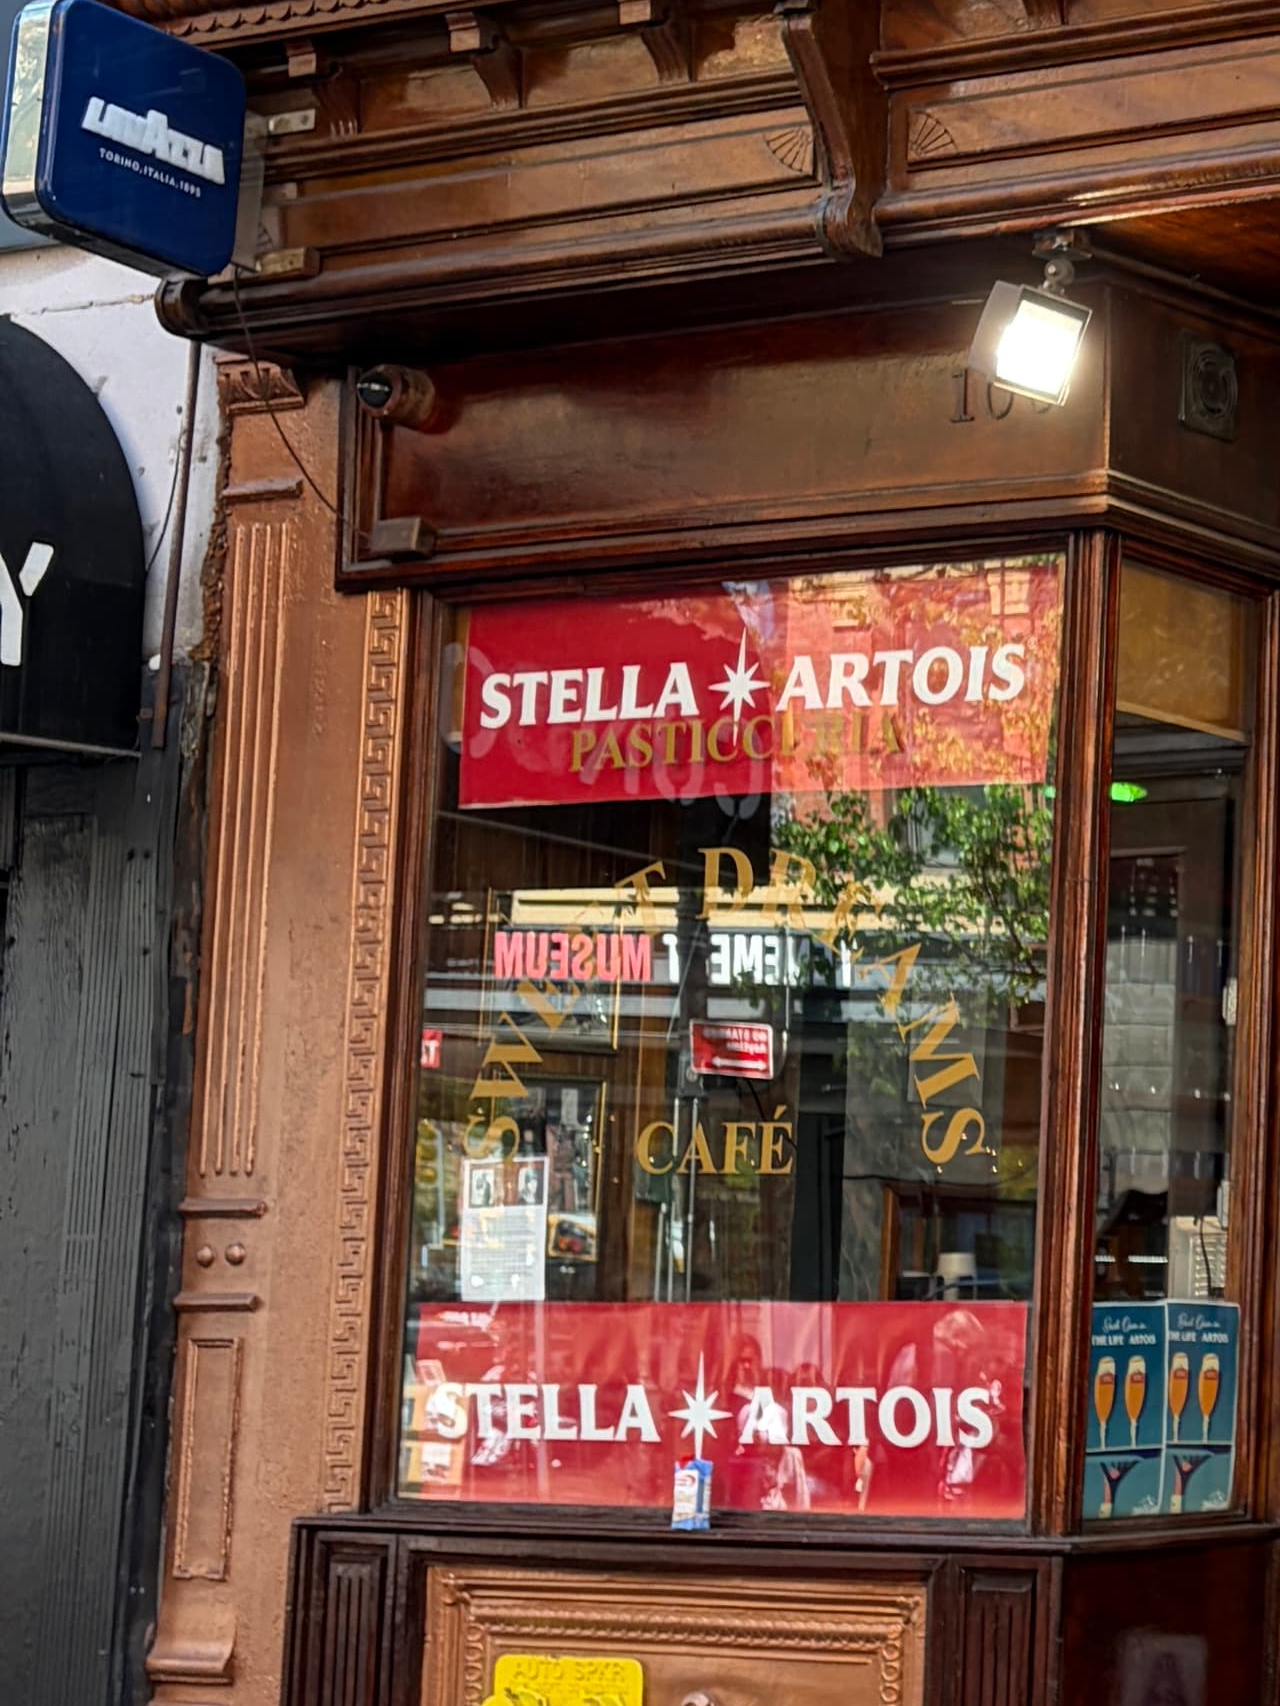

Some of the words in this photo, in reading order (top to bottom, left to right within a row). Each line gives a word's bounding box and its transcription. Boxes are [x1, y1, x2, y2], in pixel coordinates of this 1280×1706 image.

[81, 96, 225, 185] LAVAZZA
[479, 662, 700, 729] STELLA
[775, 643, 1026, 713] ARTOIS
[636, 1103, 794, 1176] CAFÉ
[432, 1382, 662, 1443] STELLA
[738, 1385, 994, 1450] ARTOIS
